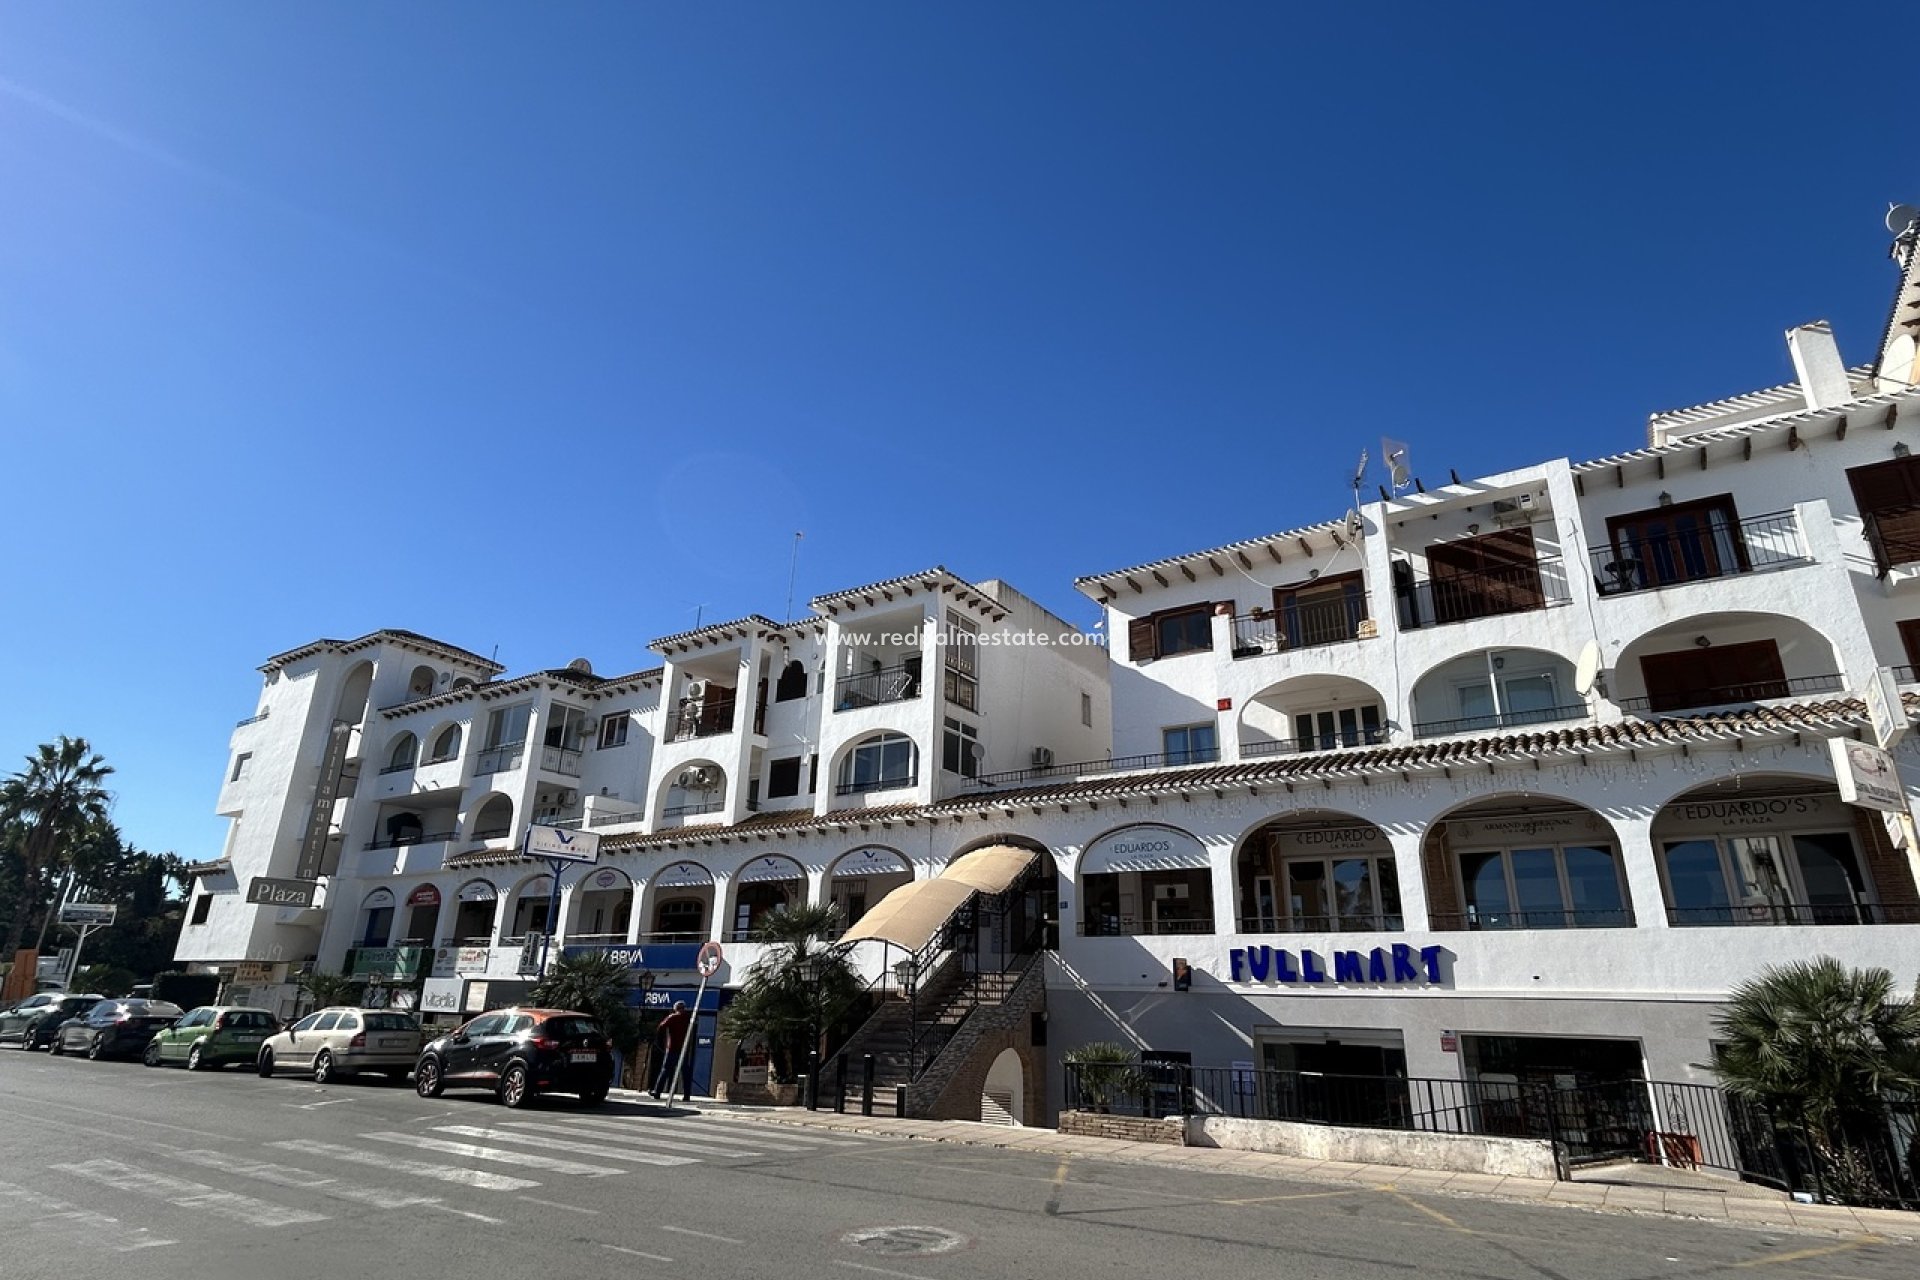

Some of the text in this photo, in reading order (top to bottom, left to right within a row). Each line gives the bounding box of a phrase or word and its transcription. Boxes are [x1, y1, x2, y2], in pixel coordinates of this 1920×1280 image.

[1685, 798, 1807, 819] EDUARDO'S
[1739, 816, 1773, 824] PLAZA
[255, 883, 307, 903] Plaza
[610, 948, 643, 965] BBVA
[1230, 943, 1443, 983] FULL MART
